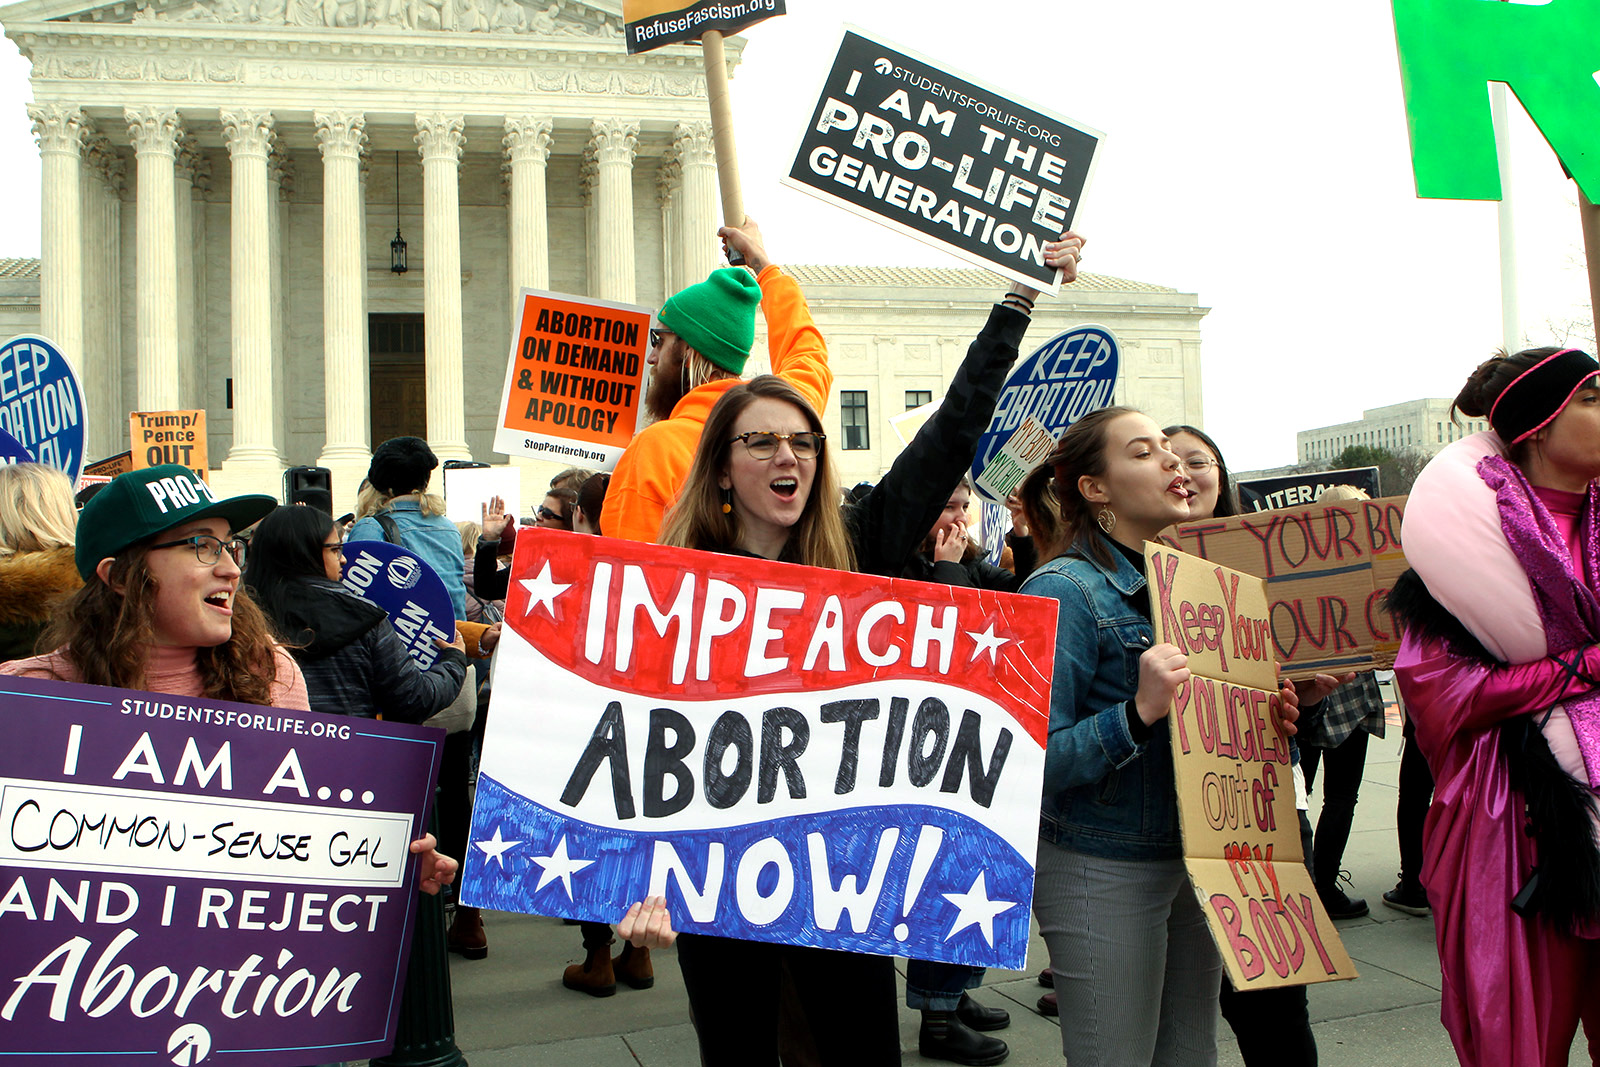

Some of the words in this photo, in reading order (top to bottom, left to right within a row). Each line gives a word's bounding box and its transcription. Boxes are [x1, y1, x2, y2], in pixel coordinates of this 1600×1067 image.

[635, 0, 775, 42] RefuseFascism.org
[258, 65, 323, 81] EQUAL
[328, 67, 402, 83] JUSTICE
[412, 70, 475, 86] UNDER
[481, 73, 516, 87] LAW
[892, 66, 1061, 148] STUDENTSFORLIFE.ORG
[845, 70, 862, 96] I
[878, 88, 957, 137] AM
[978, 124, 1067, 185] THE
[816, 96, 1071, 234] PRO-LIFE
[809, 145, 1049, 267] GENERATION
[522, 336, 551, 362] ON
[555, 341, 639, 377] DEMAND
[536, 308, 639, 347] ABORTION
[1028, 333, 1111, 381] KEEP
[0, 344, 50, 402] EEP
[518, 369, 534, 391] &
[540, 370, 635, 407] WITHOUT
[984, 379, 1111, 433] ABORTION
[138, 412, 198, 429] Trump/
[143, 430, 195, 443] Pence
[525, 398, 619, 434] APOLOGY
[147, 445, 194, 467] OUT
[524, 438, 606, 462] StopPatriarchy.org
[1241, 506, 1362, 577] YOUR
[1363, 502, 1403, 554] BO
[584, 562, 958, 685] IMPEACH
[1151, 552, 1229, 672] Keep
[1214, 566, 1270, 661] Your
[1271, 596, 1358, 662] OUR
[121, 698, 351, 740] STUDENTSFORLIFE.ORG
[1173, 674, 1289, 765] POLICIES
[63, 724, 83, 776] I
[112, 731, 234, 791] AM
[263, 748, 375, 804] A...
[559, 697, 1013, 820] ABORTION
[1252, 762, 1279, 832] of
[11, 799, 311, 861] COMMON-SENSE
[328, 831, 389, 868] GAL
[0, 875, 140, 924] AND
[161, 885, 176, 927] I
[197, 887, 389, 933] REJECT
[648, 824, 946, 942] NOW!
[1209, 893, 1338, 982] BODY
[1, 928, 362, 1022] Abortion
